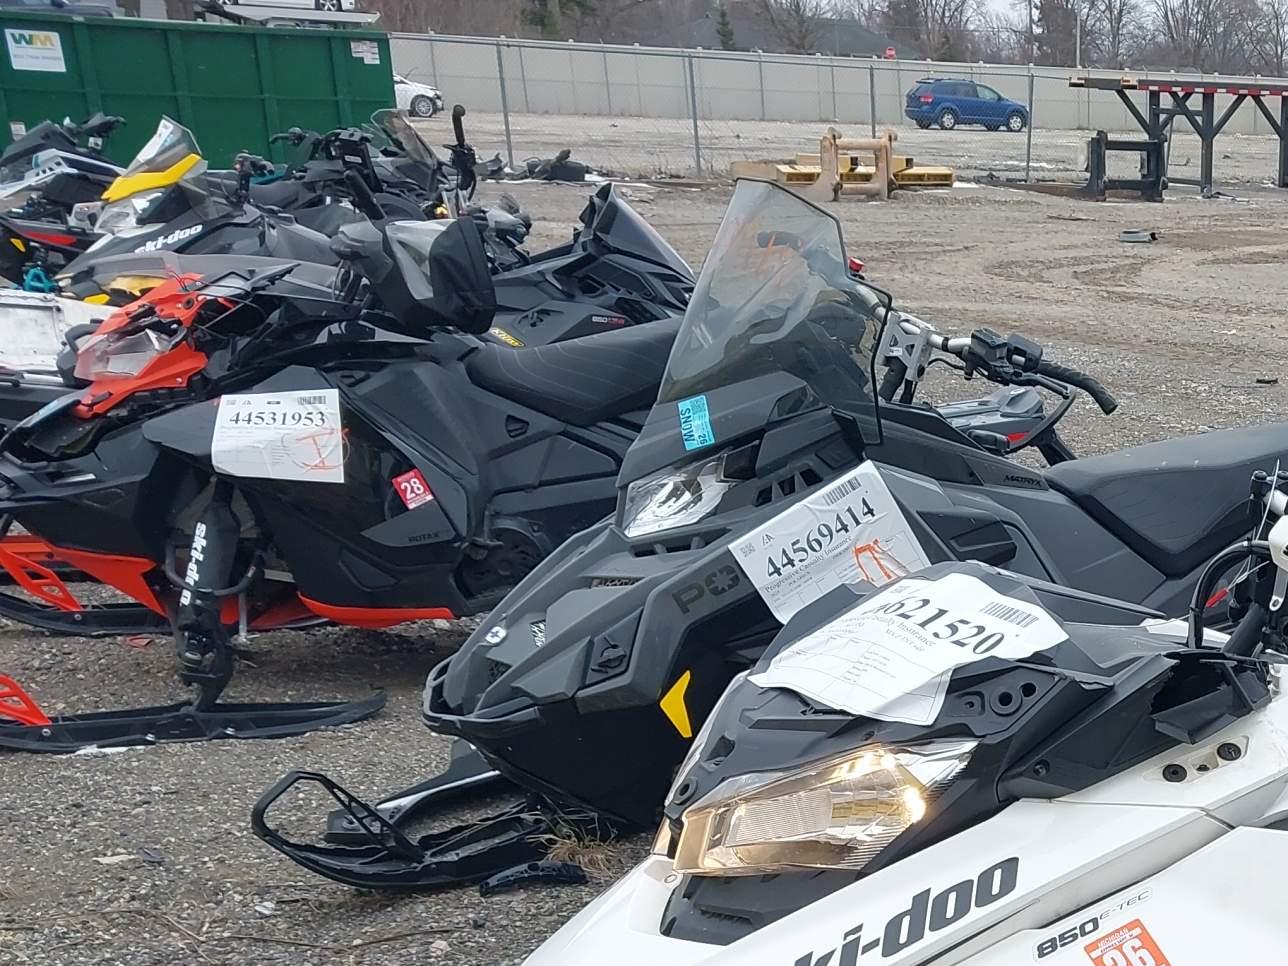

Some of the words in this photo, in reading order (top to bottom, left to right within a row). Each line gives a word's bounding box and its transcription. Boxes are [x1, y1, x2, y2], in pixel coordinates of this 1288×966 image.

[9, 32, 55, 47] WM
[229, 411, 326, 427] 44531953
[680, 407, 696, 442] SNOW
[400, 478, 424, 499] 28
[766, 496, 876, 580] 44569414
[1036, 916, 1100, 959] 850
